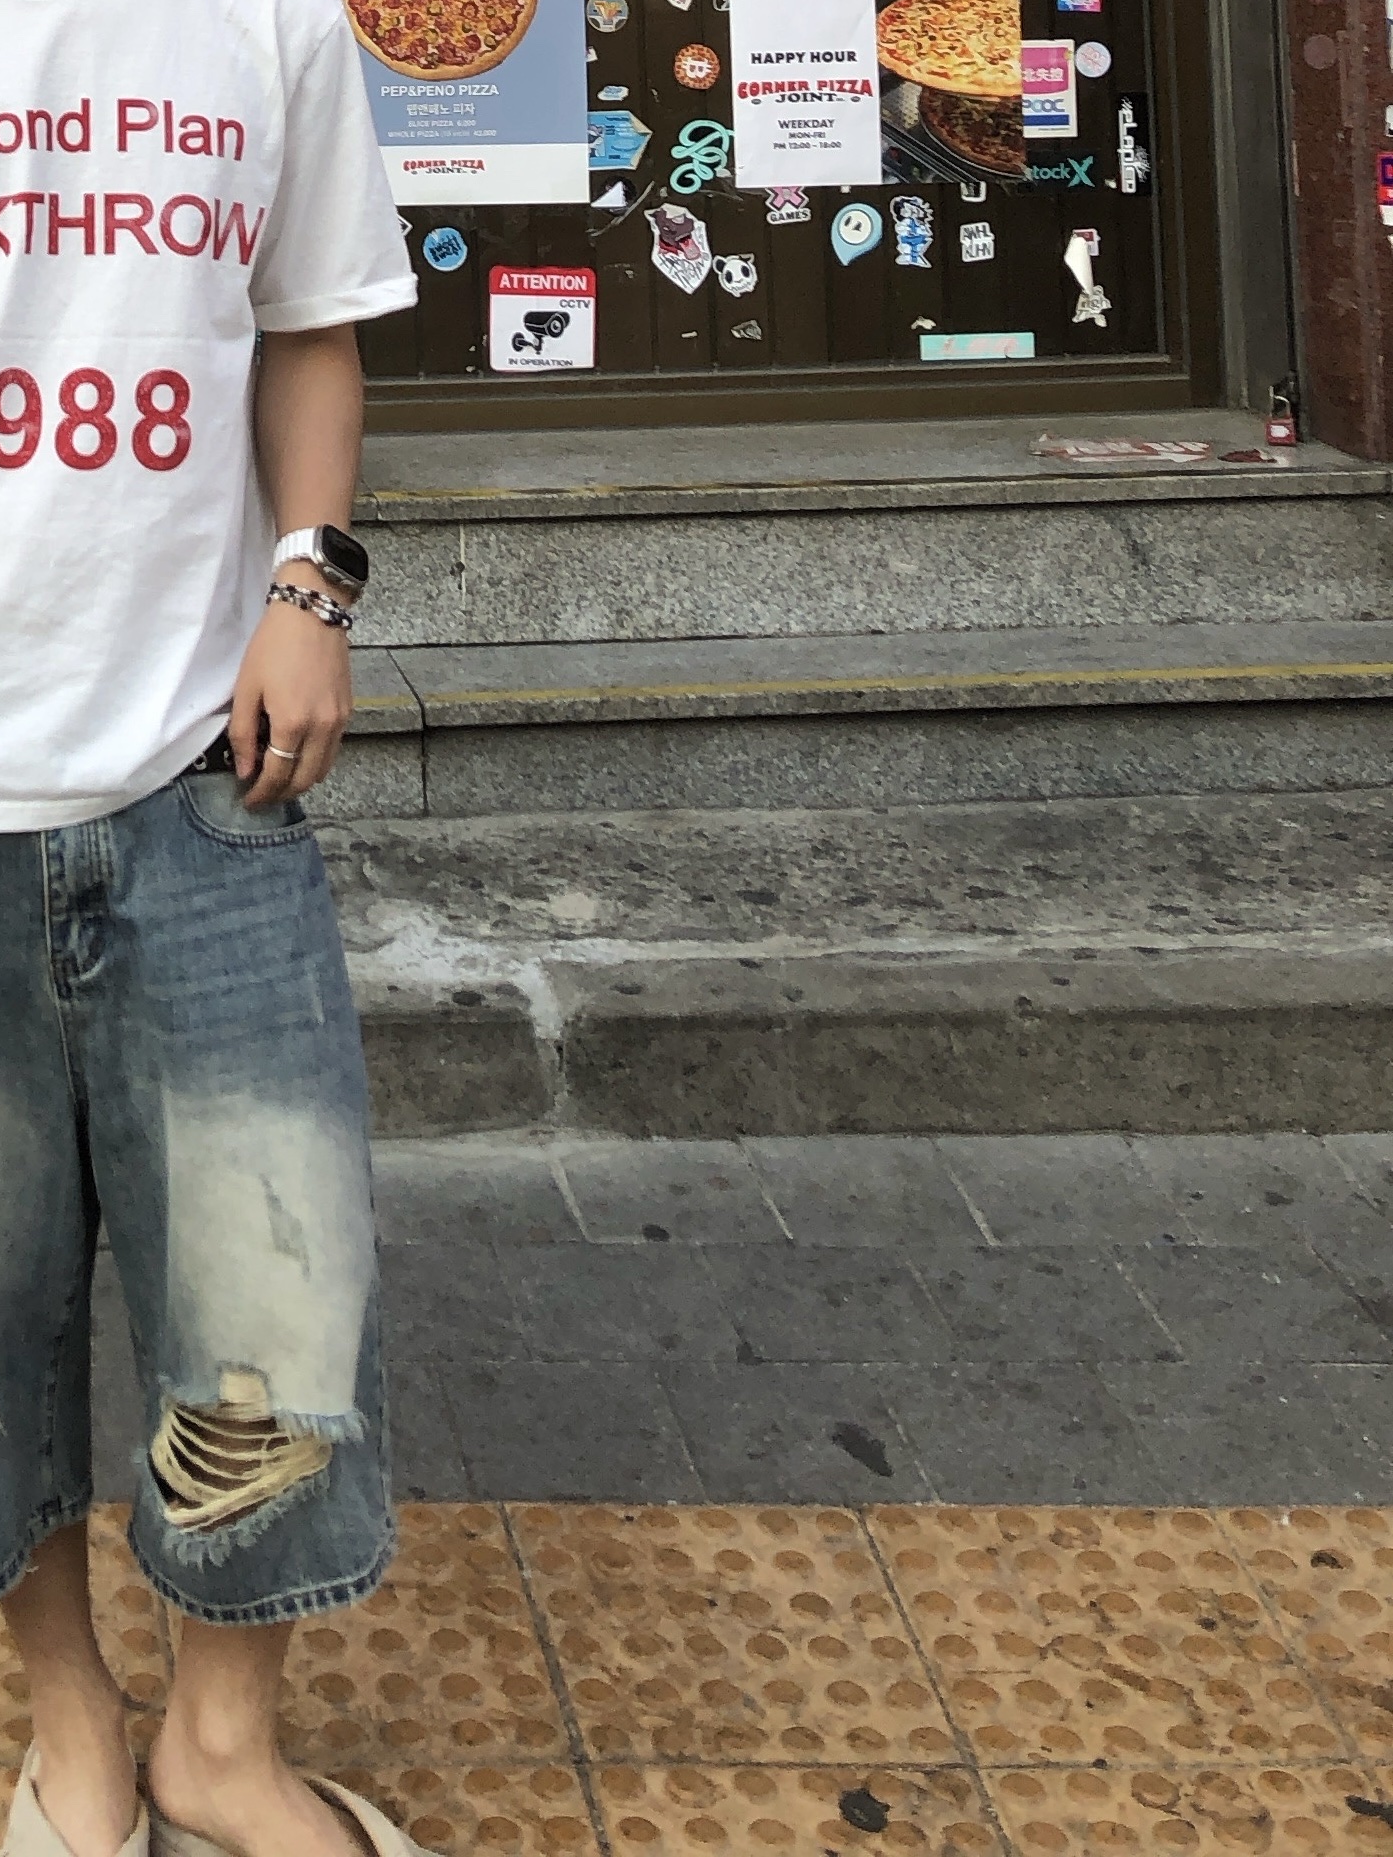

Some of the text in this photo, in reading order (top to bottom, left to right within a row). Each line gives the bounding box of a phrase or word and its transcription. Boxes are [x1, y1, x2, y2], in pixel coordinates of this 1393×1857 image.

[751, 50, 858, 64] HAPPY HOUR
[380, 84, 499, 97] PEP&PENO PIZZA
[738, 79, 874, 99] CORNER PIZZA
[775, 93, 837, 103] JOINT
[116, 97, 245, 163] Plan
[778, 119, 836, 129] WEEKDAY
[770, 210, 809, 222] GAMES
[500, 273, 588, 291] ATTENTION
[559, 299, 590, 309] CCTV
[508, 357, 573, 367] IN OPERATION
